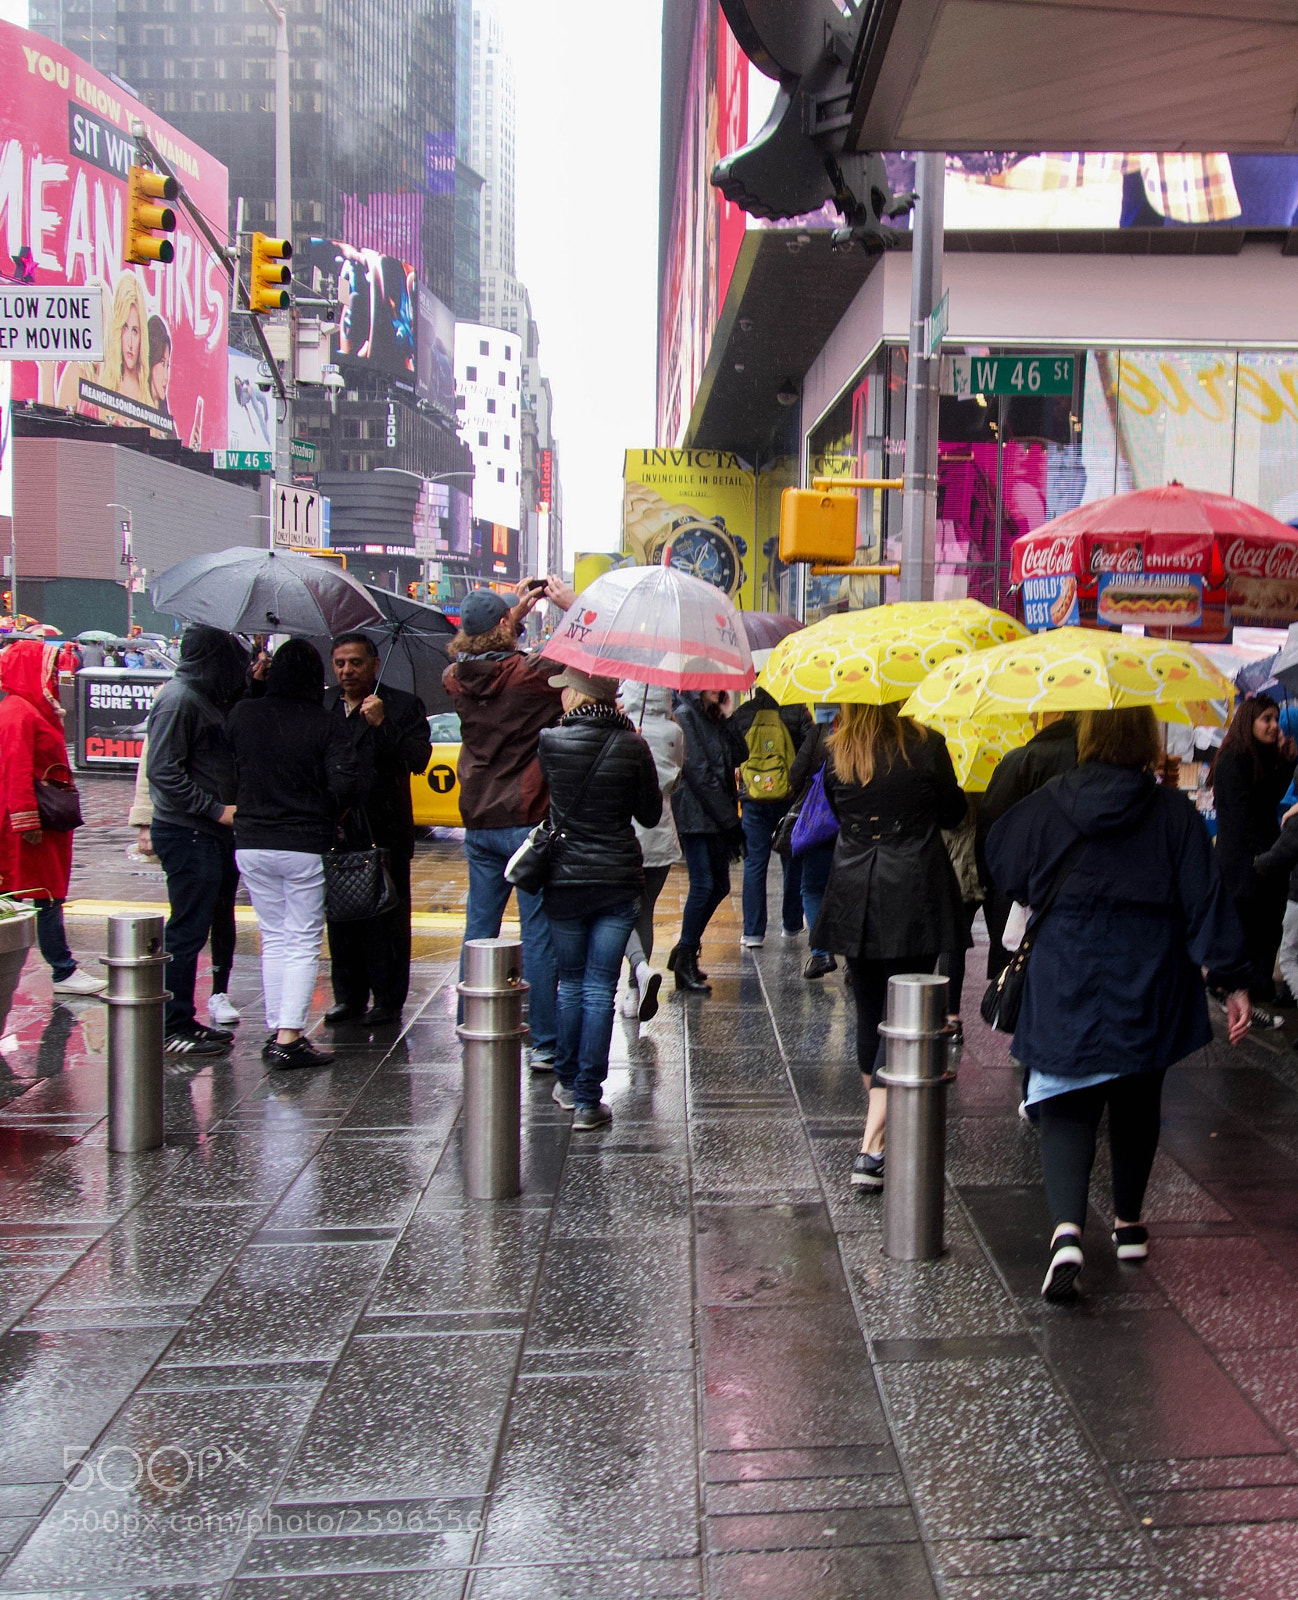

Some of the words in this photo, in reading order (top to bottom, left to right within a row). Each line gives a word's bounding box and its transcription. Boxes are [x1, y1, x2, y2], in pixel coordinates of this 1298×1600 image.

[22, 45, 70, 90] YOU
[75, 73, 121, 124] KNOW
[154, 130, 200, 181] WANNA
[72, 113, 100, 159] SIT
[104, 129, 139, 177] WIT
[0, 297, 38, 318] LOW
[46, 297, 90, 319] ZONE
[26, 327, 92, 349] MOVING
[977, 361, 998, 391] W
[1010, 361, 1041, 391] 46
[1053, 360, 1069, 380] St
[387, 403, 396, 448] 1500
[228, 453, 239, 468] W
[244, 453, 259, 468] 46
[642, 448, 743, 470] INVICTA
[642, 473, 694, 484] INVINCIBLE
[699, 476, 708, 485] IN
[712, 477, 743, 487] DETAIL
[1146, 553, 1204, 570] thirsty?
[1024, 575, 1067, 602] WORLD'S
[1109, 573, 1145, 587] JOHN'S
[1149, 573, 1190, 588] FAMOUS
[575, 607, 586, 622] I
[1025, 602, 1049, 625] BEST
[565, 622, 592, 643] NY
[90, 683, 155, 698] BROADW
[89, 696, 132, 710] SURE
[134, 698, 155, 711] TH
[432, 769, 450, 791] T
